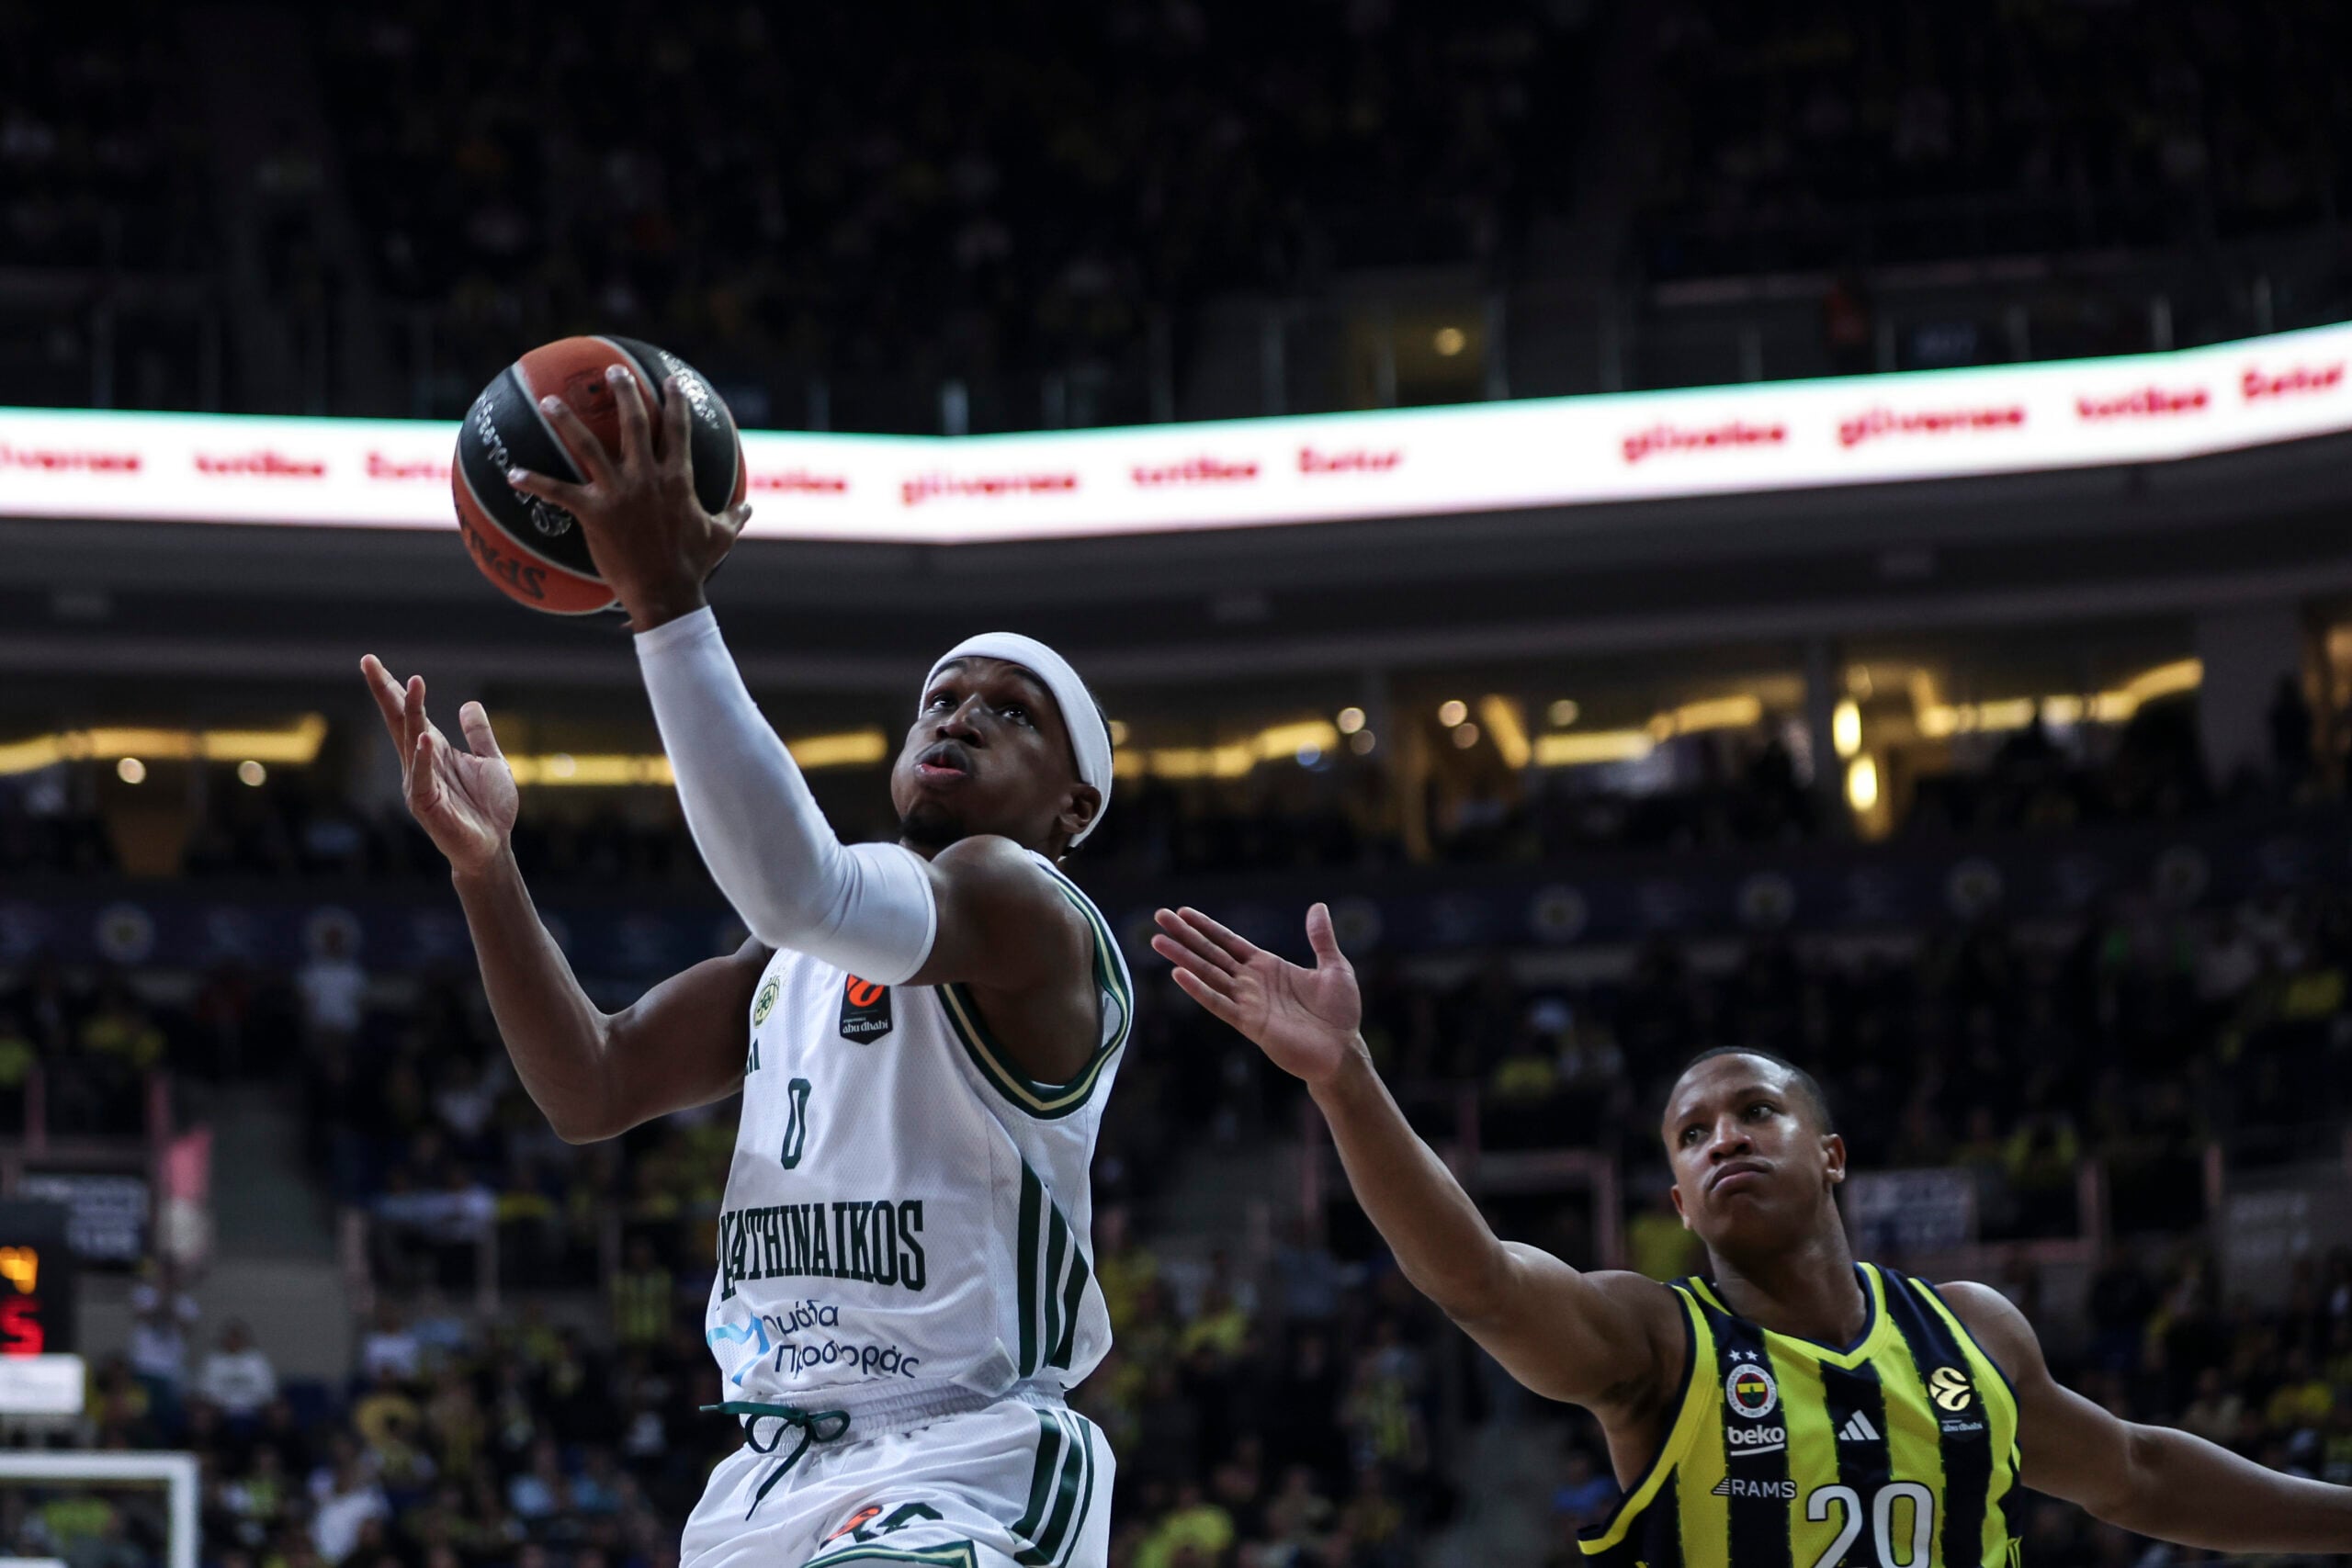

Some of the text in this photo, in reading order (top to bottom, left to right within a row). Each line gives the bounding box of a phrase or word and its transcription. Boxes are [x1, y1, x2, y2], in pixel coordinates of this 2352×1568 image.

[781, 1077, 812, 1170] 0
[1727, 1425, 1785, 1444] beko
[1732, 1479, 1796, 1498] RAMS
[1807, 1482, 1934, 1568] 20
